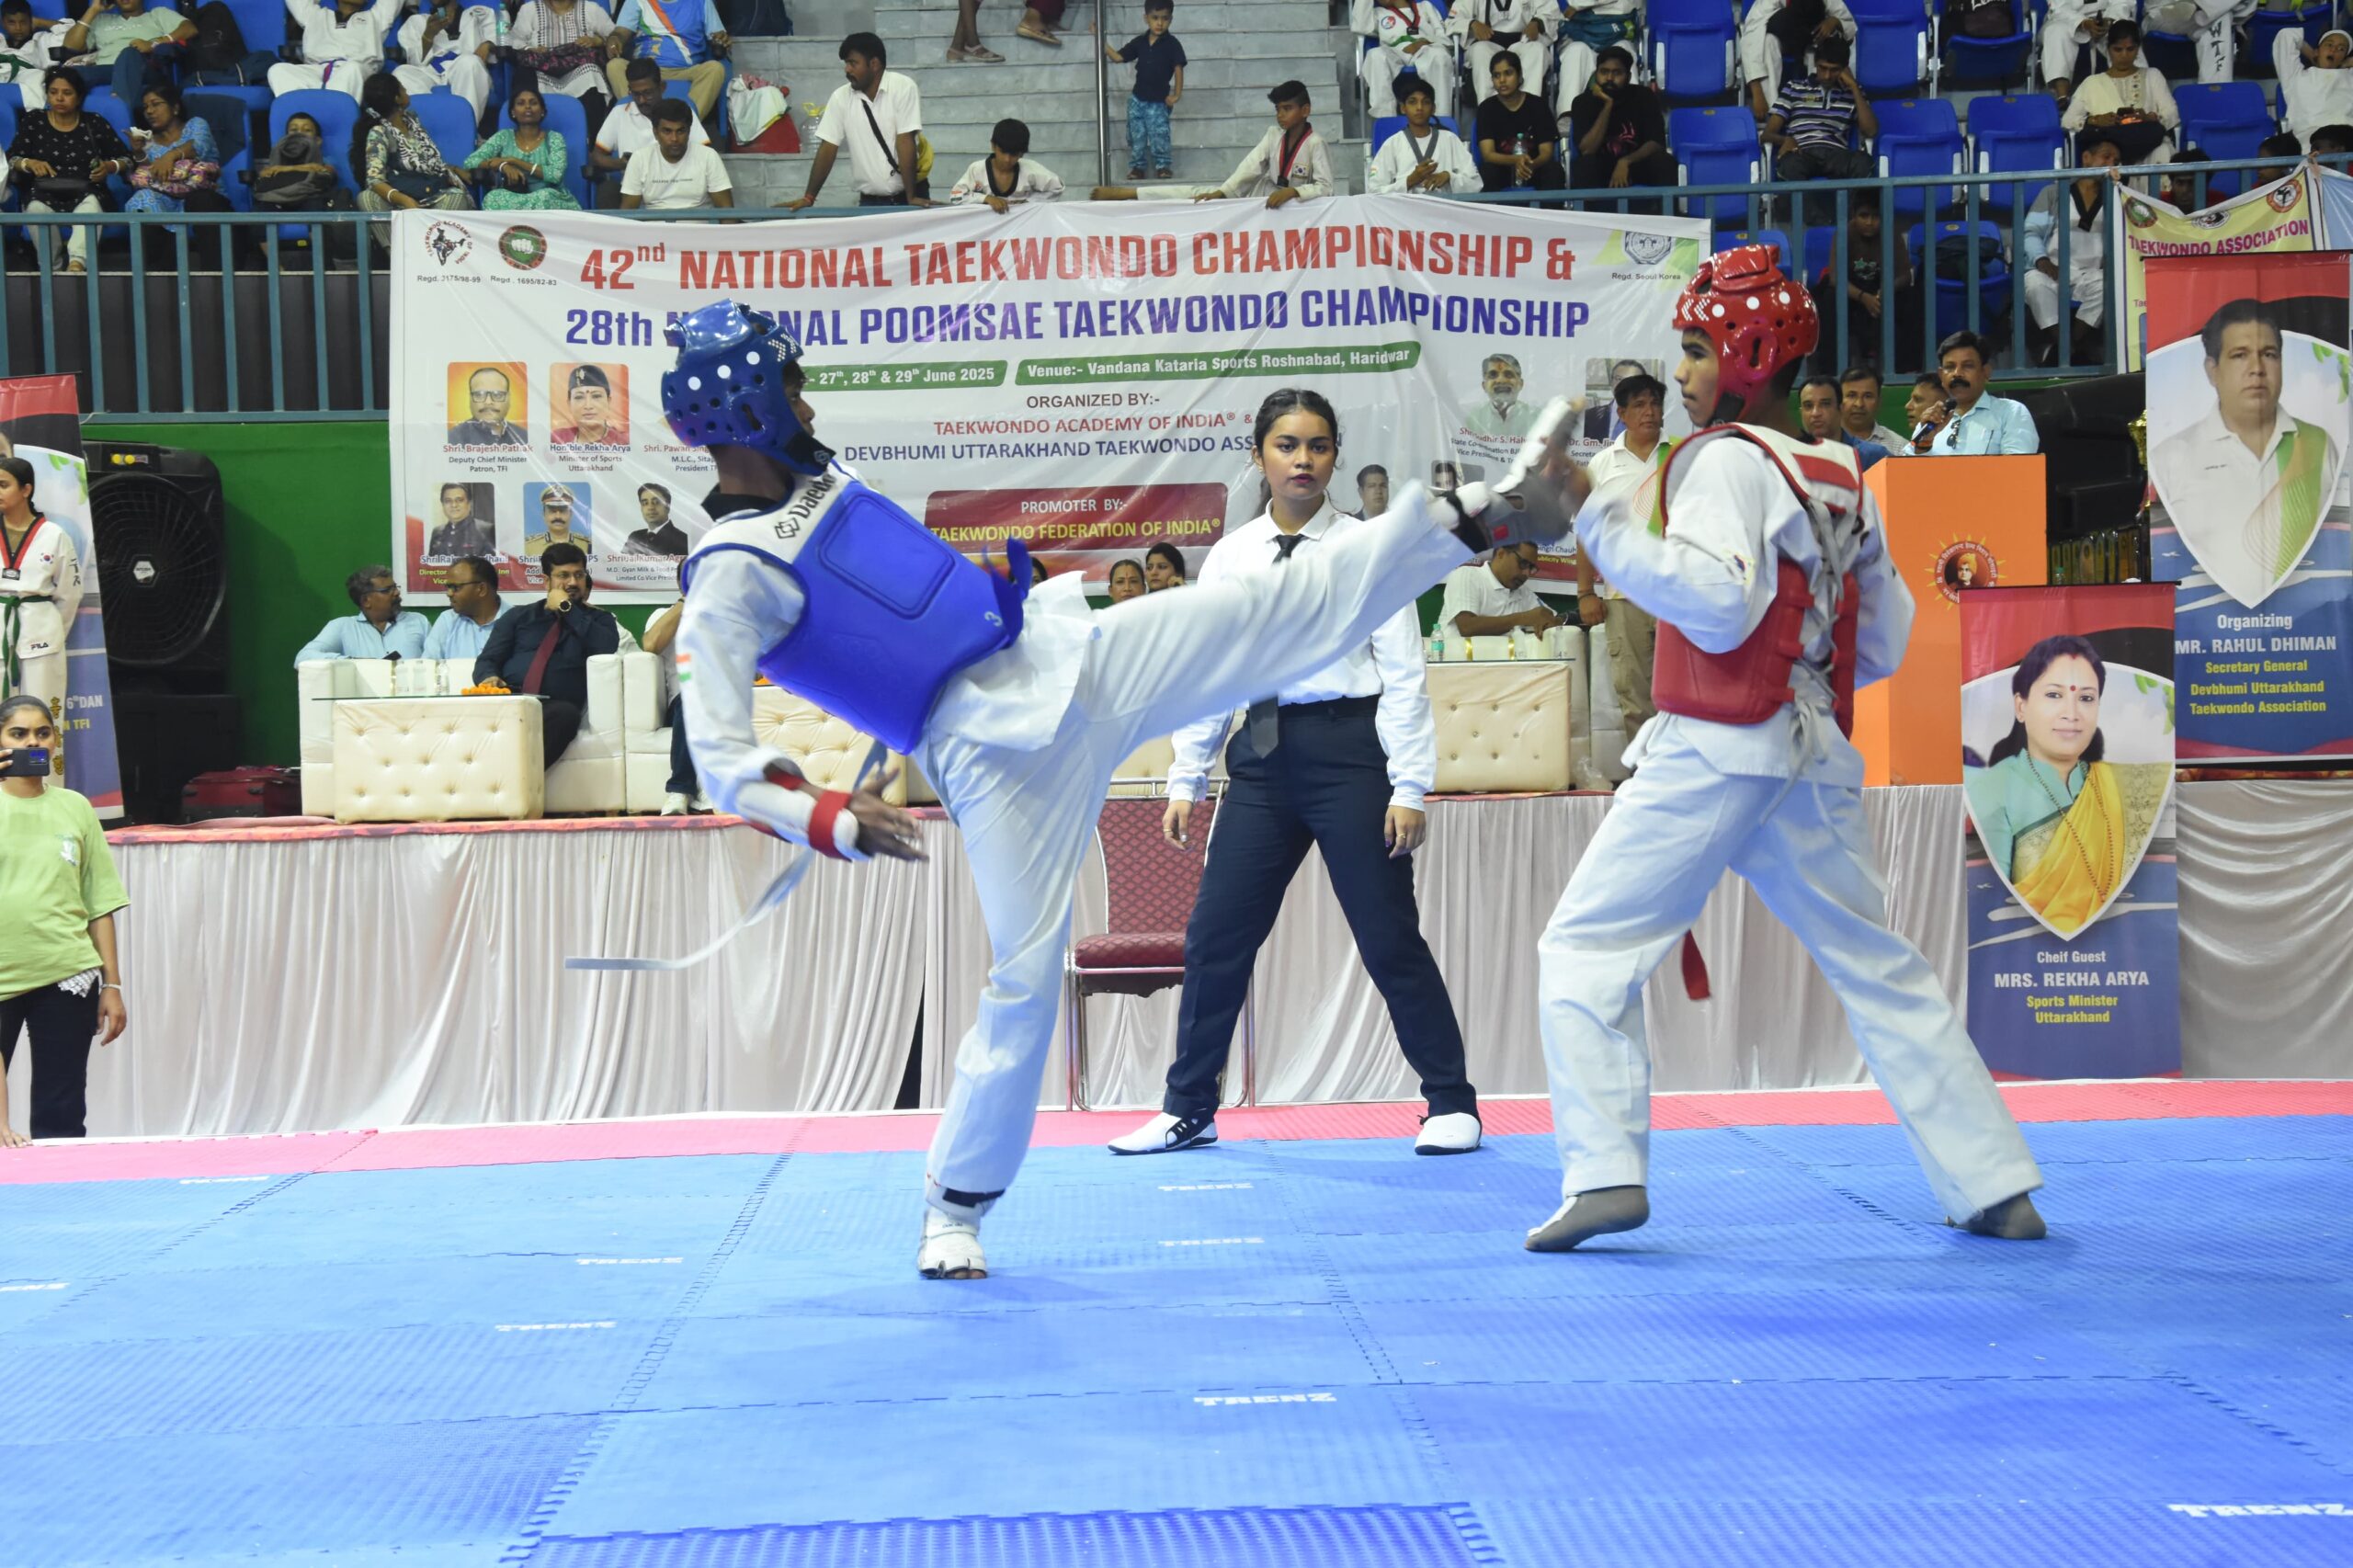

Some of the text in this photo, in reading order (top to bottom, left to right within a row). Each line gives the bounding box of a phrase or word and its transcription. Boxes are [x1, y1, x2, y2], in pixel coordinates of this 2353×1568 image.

[2129, 220, 2309, 256] TAEKWONDO ASSOCIATION
[581, 242, 665, 290] 42nd
[680, 247, 892, 290] NATIONAL
[904, 234, 1177, 286] TAEKWONDO
[1193, 224, 1532, 278] CHAMPIONSHIP
[1547, 238, 1575, 280] &
[565, 309, 653, 347] 28th
[860, 301, 1043, 345] POOMSAE
[1053, 290, 1287, 338] TAEKWONDO
[1301, 285, 1589, 337] CHAMPIONSHIP
[1028, 348, 1410, 378] Venue:- Vandana Kataria Sports Roshnabad, Haridwar
[819, 370, 848, 385] 27th,
[852, 369, 877, 383] 28th
[881, 372, 892, 383] &
[895, 368, 920, 383] 29th
[923, 369, 956, 382] June
[961, 368, 995, 381] 2025
[1027, 393, 1122, 409] ORGANIZED
[934, 418, 1050, 436] TAEKWONDO
[1055, 416, 1143, 433] ACADEMY
[1149, 415, 1171, 430] OF
[1245, 415, 1252, 424] &
[466, 445, 499, 454] Brajesh
[611, 445, 631, 453] Arya
[845, 444, 945, 461] DEVBHUMI
[951, 441, 1090, 459] UTTARAKHAND
[1096, 437, 1216, 455] TAEKWONDO
[1020, 499, 1097, 514] PROMOTER
[930, 525, 1034, 542] TAEKWONDO
[1039, 522, 1136, 540] FEDERATION
[1141, 521, 1162, 536] OF
[2217, 614, 2292, 631] Organizing
[2175, 636, 2336, 654] MR. RAHUL DHIMAN
[2206, 660, 2308, 675] Secretary General
[2190, 681, 2325, 696] Devbhumi Uttarakhand
[79, 695, 103, 709] DAN
[2189, 700, 2326, 715] Taekwondo Association
[2037, 950, 2106, 963] Cheif Guest
[1995, 971, 2150, 988] MRS. REKHA ARYA
[2027, 994, 2119, 1008] Sports Minister
[2035, 1011, 2110, 1023] Uttarakhand
[1194, 1392, 1336, 1406] TRENZ
